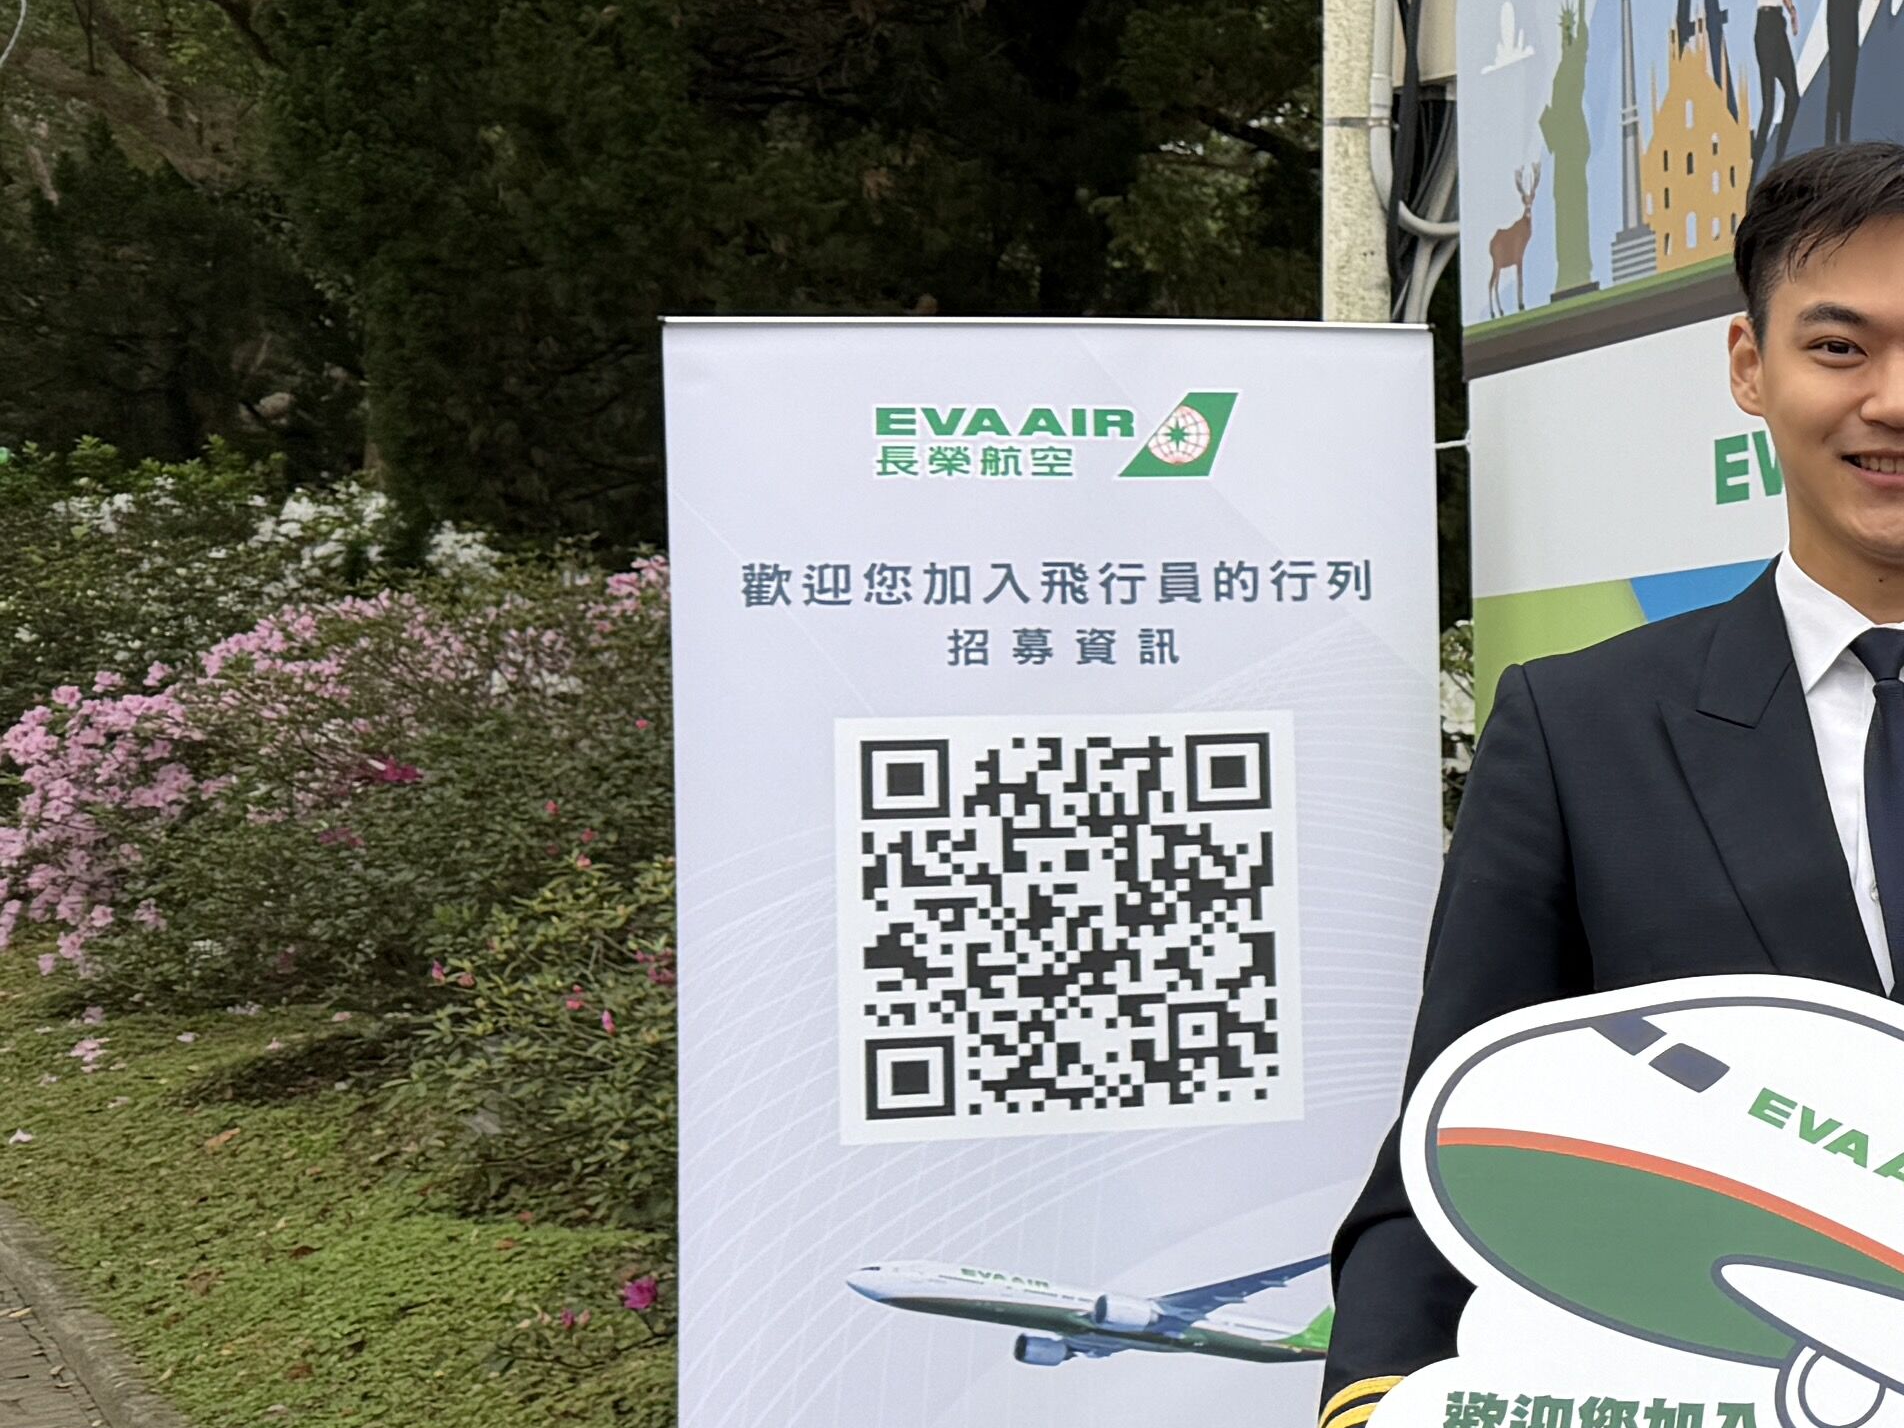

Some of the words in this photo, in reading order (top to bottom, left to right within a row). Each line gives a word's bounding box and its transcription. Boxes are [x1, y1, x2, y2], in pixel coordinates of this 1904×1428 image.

[875, 445, 1074, 477] 長榮航空
[741, 559, 1373, 608] 歡迎您加入飛行員的行列
[947, 627, 1181, 667] 招募資訊
